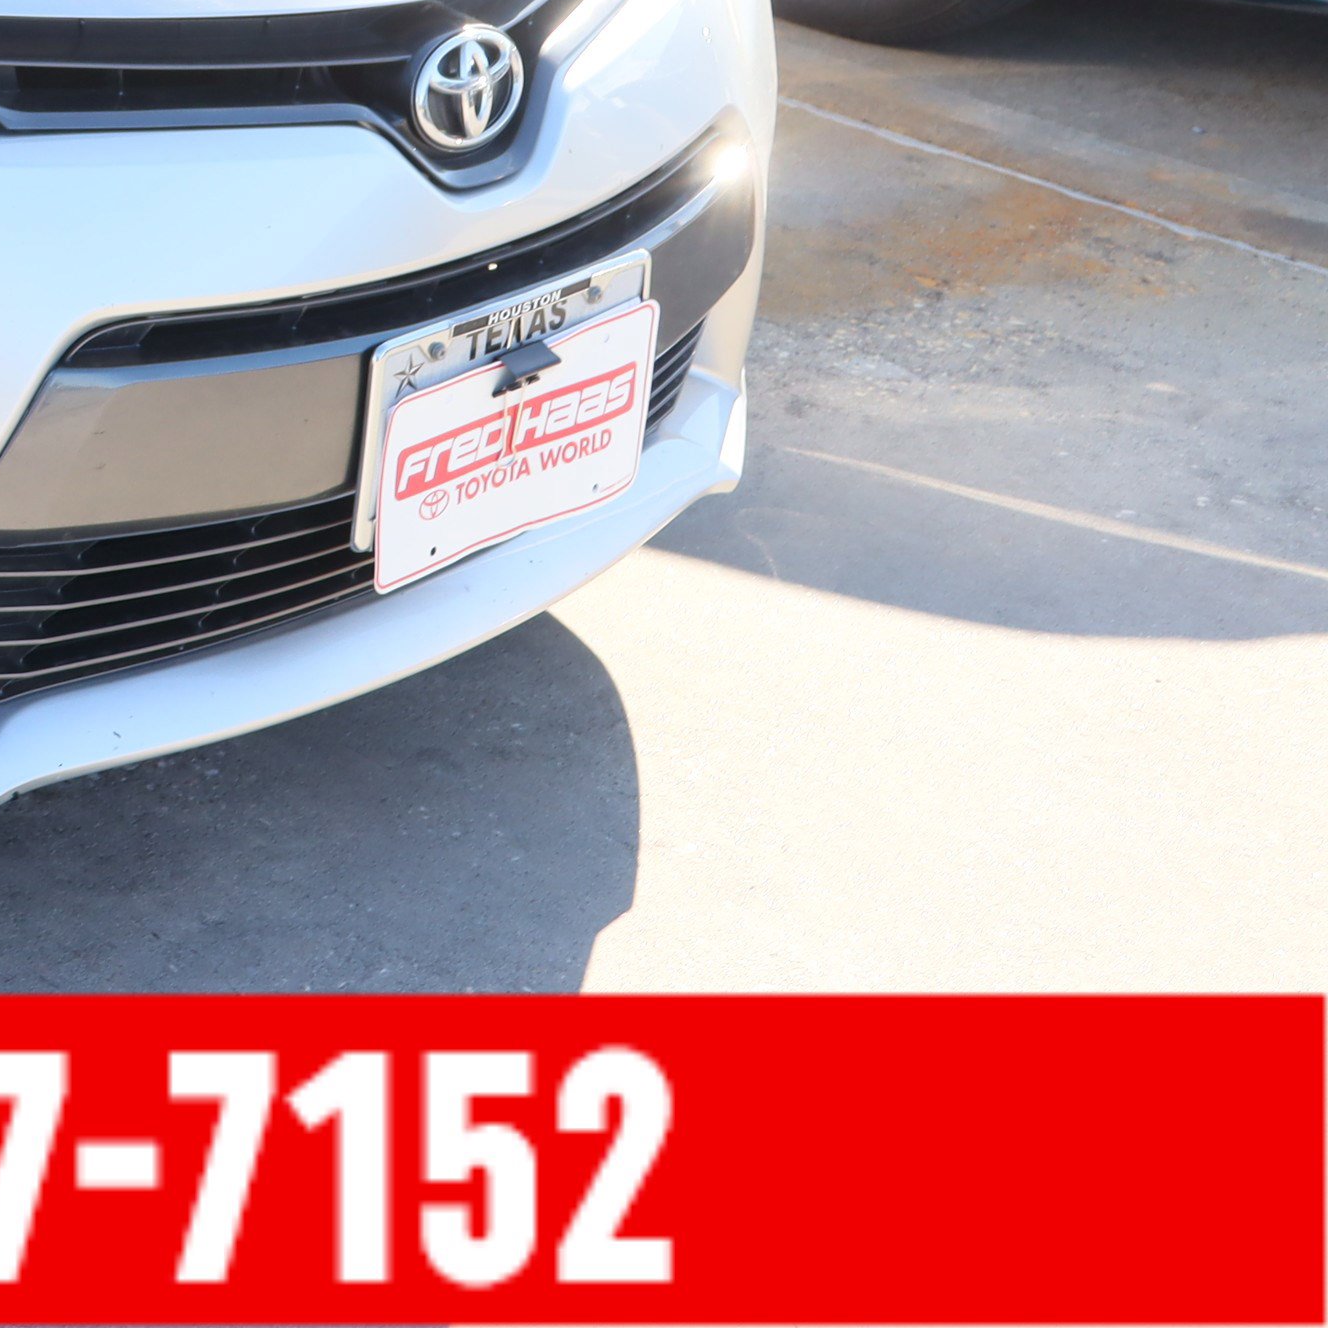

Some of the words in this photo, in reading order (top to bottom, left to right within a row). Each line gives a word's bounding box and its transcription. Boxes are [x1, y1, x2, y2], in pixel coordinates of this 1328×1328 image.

[488, 289, 562, 325] HOUSTON
[456, 456, 531, 504] TOYOTA
[540, 429, 612, 472] WORLD
